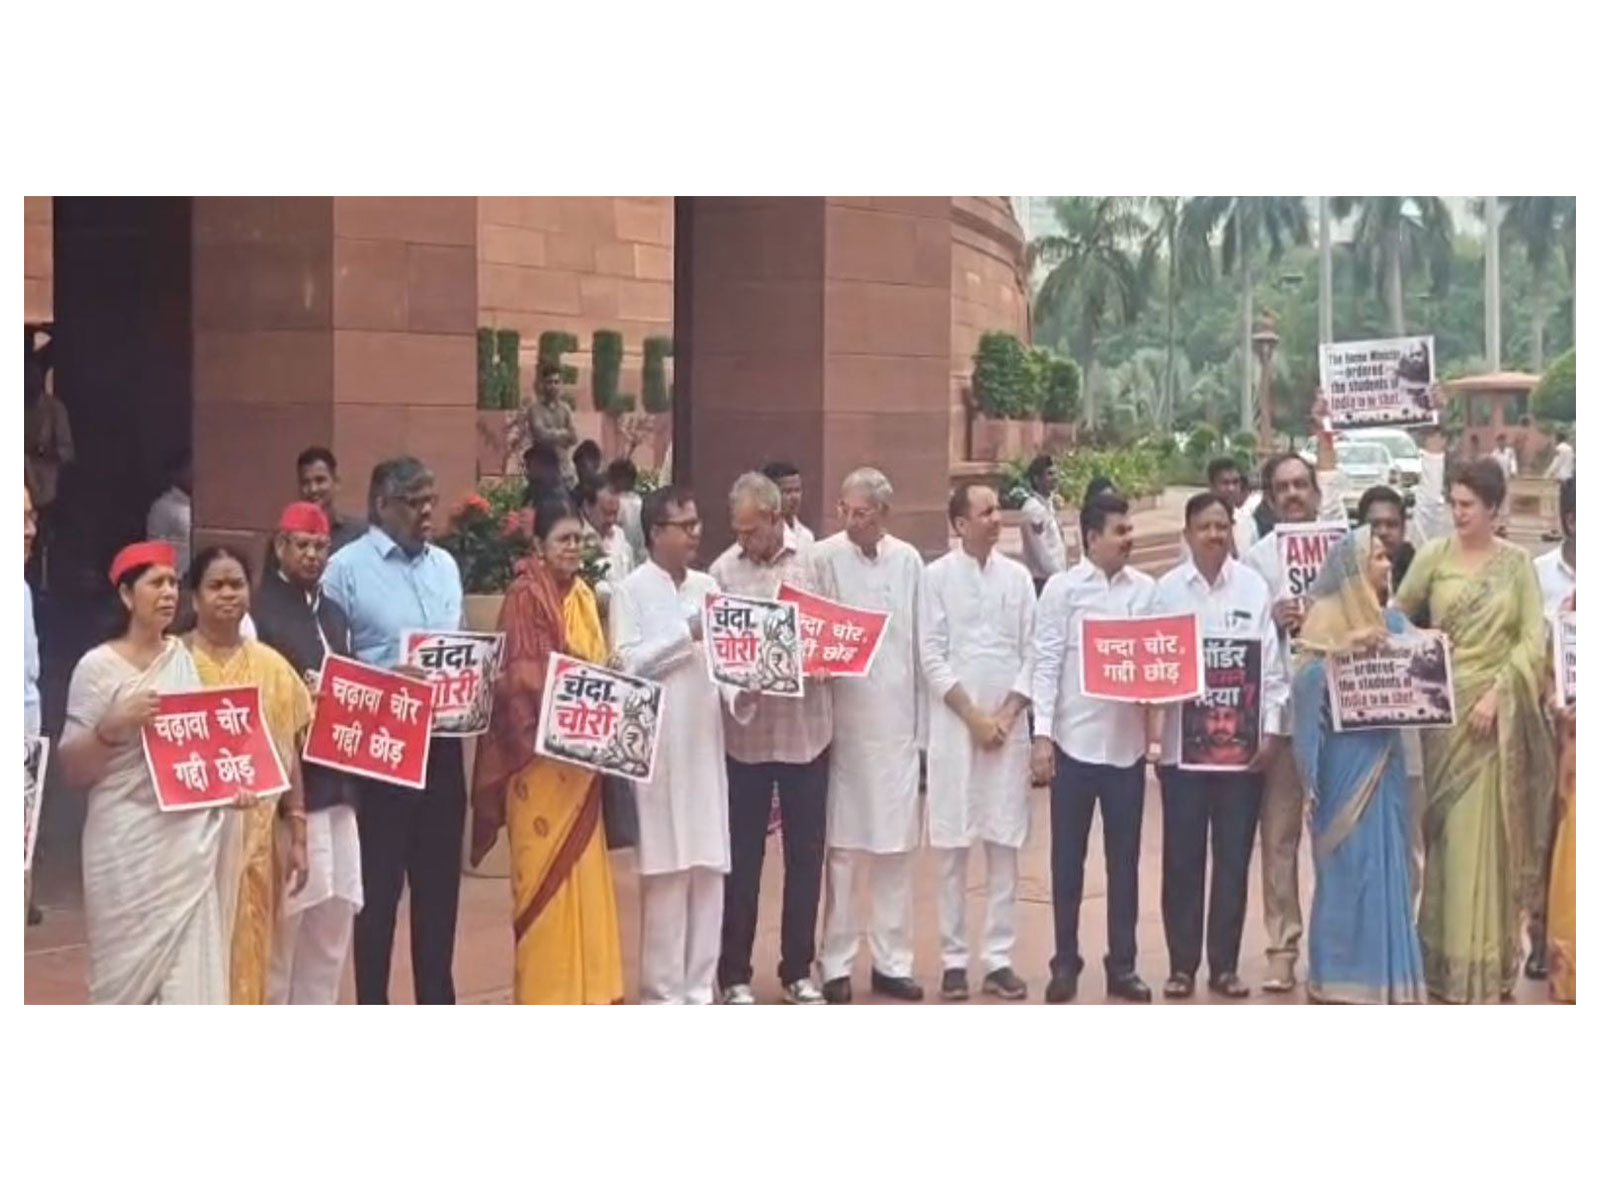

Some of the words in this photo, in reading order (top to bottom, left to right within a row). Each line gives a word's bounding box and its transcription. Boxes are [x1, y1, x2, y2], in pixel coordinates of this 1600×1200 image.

[1331, 382, 1345, 394] the
[1349, 378, 1389, 392] students
[1286, 534, 1341, 566] AMI
[1288, 567, 1317, 595] SH
[713, 630, 762, 661] चोरी
[1142, 658, 1181, 685] छोड़
[1339, 678, 1355, 691] the
[1358, 676, 1401, 690] students
[331, 676, 384, 714] चढ़ावा
[391, 687, 423, 726] चोर
[154, 710, 210, 746] चढ़ावा
[215, 698, 253, 736] चोर
[555, 700, 618, 736] चोरी
[332, 720, 363, 758] गद्दी
[370, 727, 406, 770] छोड़
[173, 751, 209, 793] गद्दी
[214, 748, 256, 785] छोड़
